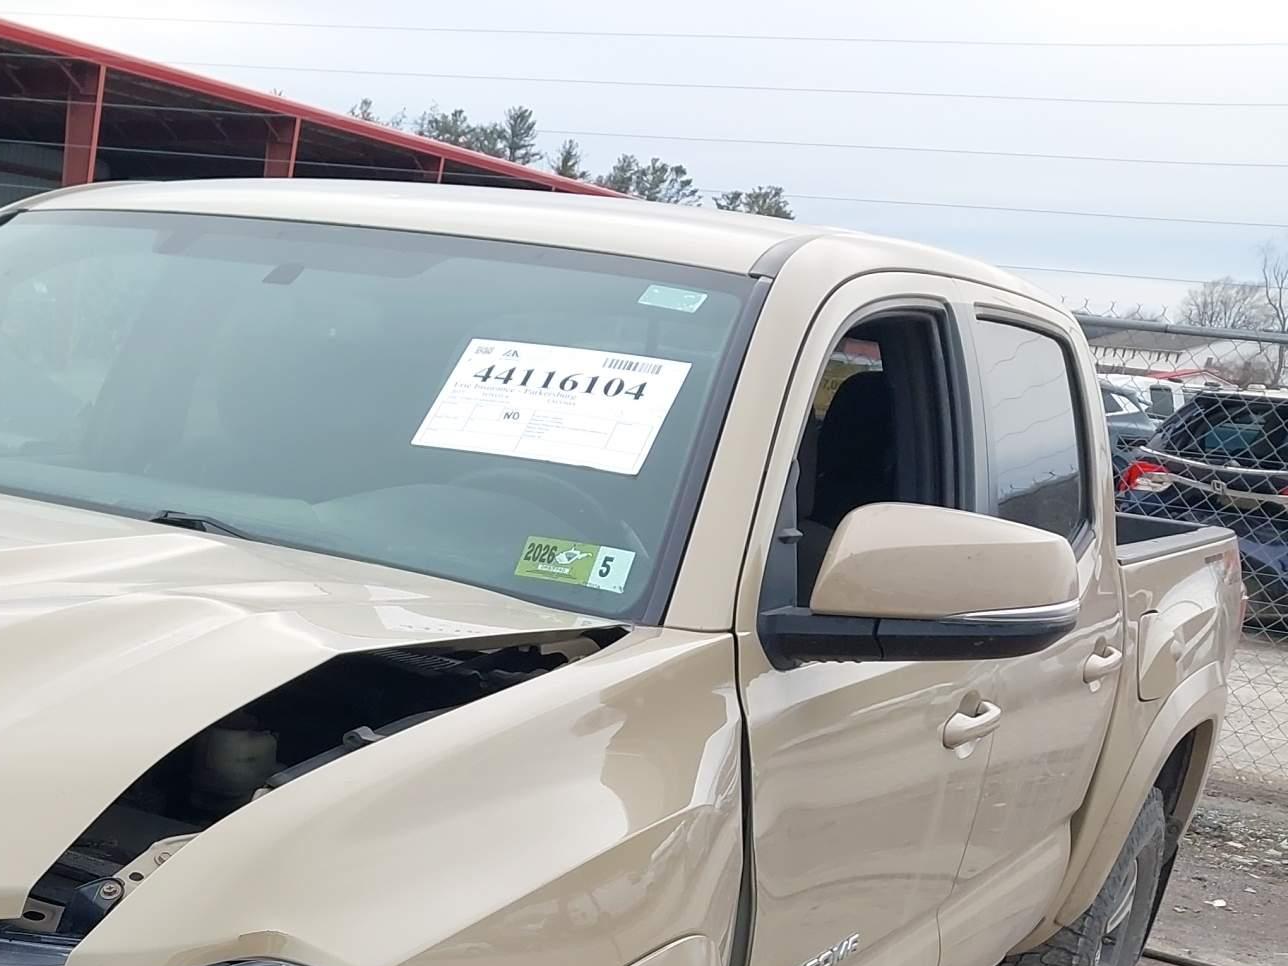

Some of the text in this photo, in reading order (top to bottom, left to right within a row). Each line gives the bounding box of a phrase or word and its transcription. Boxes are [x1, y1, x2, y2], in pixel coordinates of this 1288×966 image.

[472, 363, 649, 401] 44116104
[522, 542, 558, 564] 2026
[598, 555, 615, 578] 5
